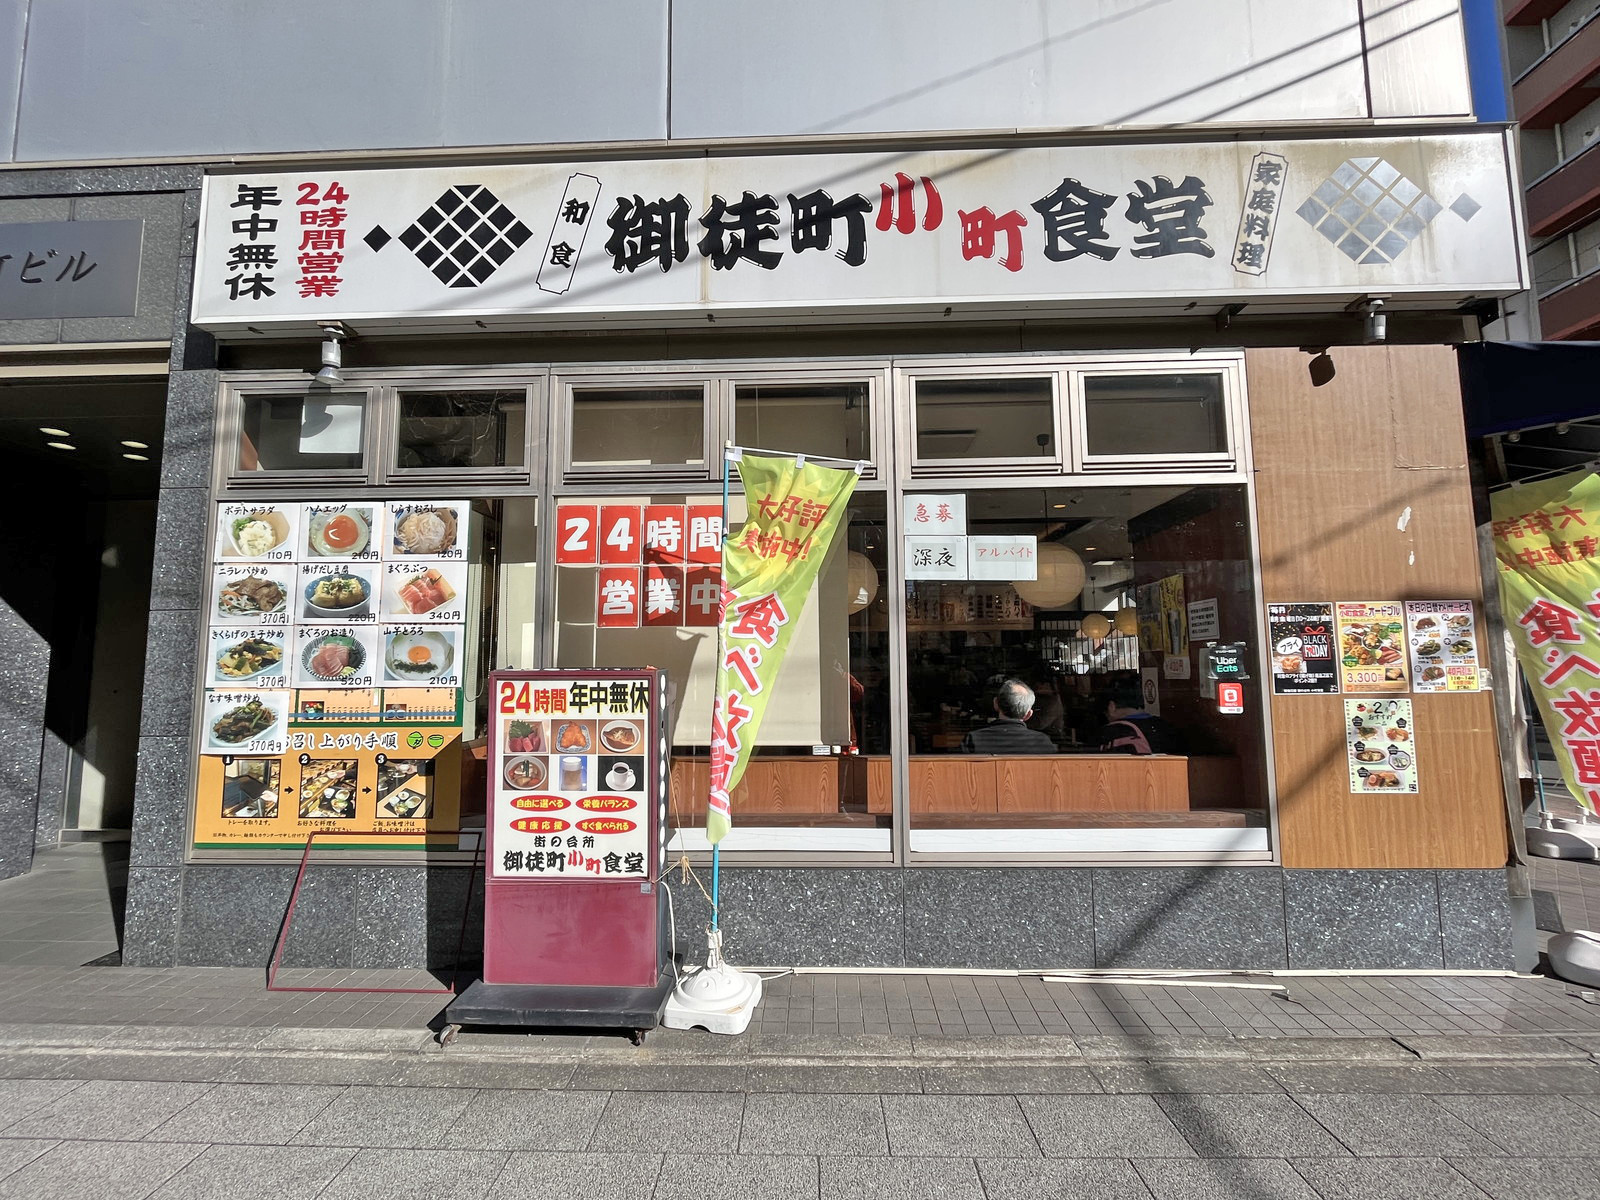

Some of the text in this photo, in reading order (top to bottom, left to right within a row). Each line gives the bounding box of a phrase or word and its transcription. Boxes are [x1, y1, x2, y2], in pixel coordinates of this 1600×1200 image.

[1237, 160, 1283, 268] 家庭料理
[603, 171, 1216, 273] 御徒町小町食堂
[550, 197, 589, 268] 和食
[224, 184, 282, 300] 年中無休
[295, 181, 349, 298] 24時間営業
[224, 506, 274, 515] ポテトサラダ
[305, 504, 347, 513] ハムエッグ
[391, 504, 437, 513] しらすおろし
[757, 493, 829, 527] 大好評
[914, 503, 953, 523] 急募
[563, 517, 723, 552] 24時間
[267, 550, 292, 560] 110円
[352, 551, 378, 560] 210円
[437, 549, 462, 558] 120円
[914, 547, 1033, 567] 深夜 アルバイト
[218, 566, 268, 576] ニラレバ炒め
[387, 564, 428, 573] まぐろぶつ
[601, 578, 721, 615] 営業中
[348, 613, 376, 622] 220円
[429, 611, 460, 620] 340円
[299, 628, 355, 637] まぐろのお造り
[383, 626, 424, 636] 山芋とろろ
[1303, 635, 1327, 644] BLACK
[1280, 639, 1299, 652] フライ
[429, 676, 457, 685] 210円
[500, 682, 649, 713] 24時間 年中無休
[378, 755, 384, 763] 3
[517, 800, 629, 808] 自由に選べる 栄養バランス
[518, 821, 629, 830] 健康応援 すぐ食べられる
[534, 835, 594, 848] 街の台所
[503, 849, 644, 875] 御徒町小町食堂
